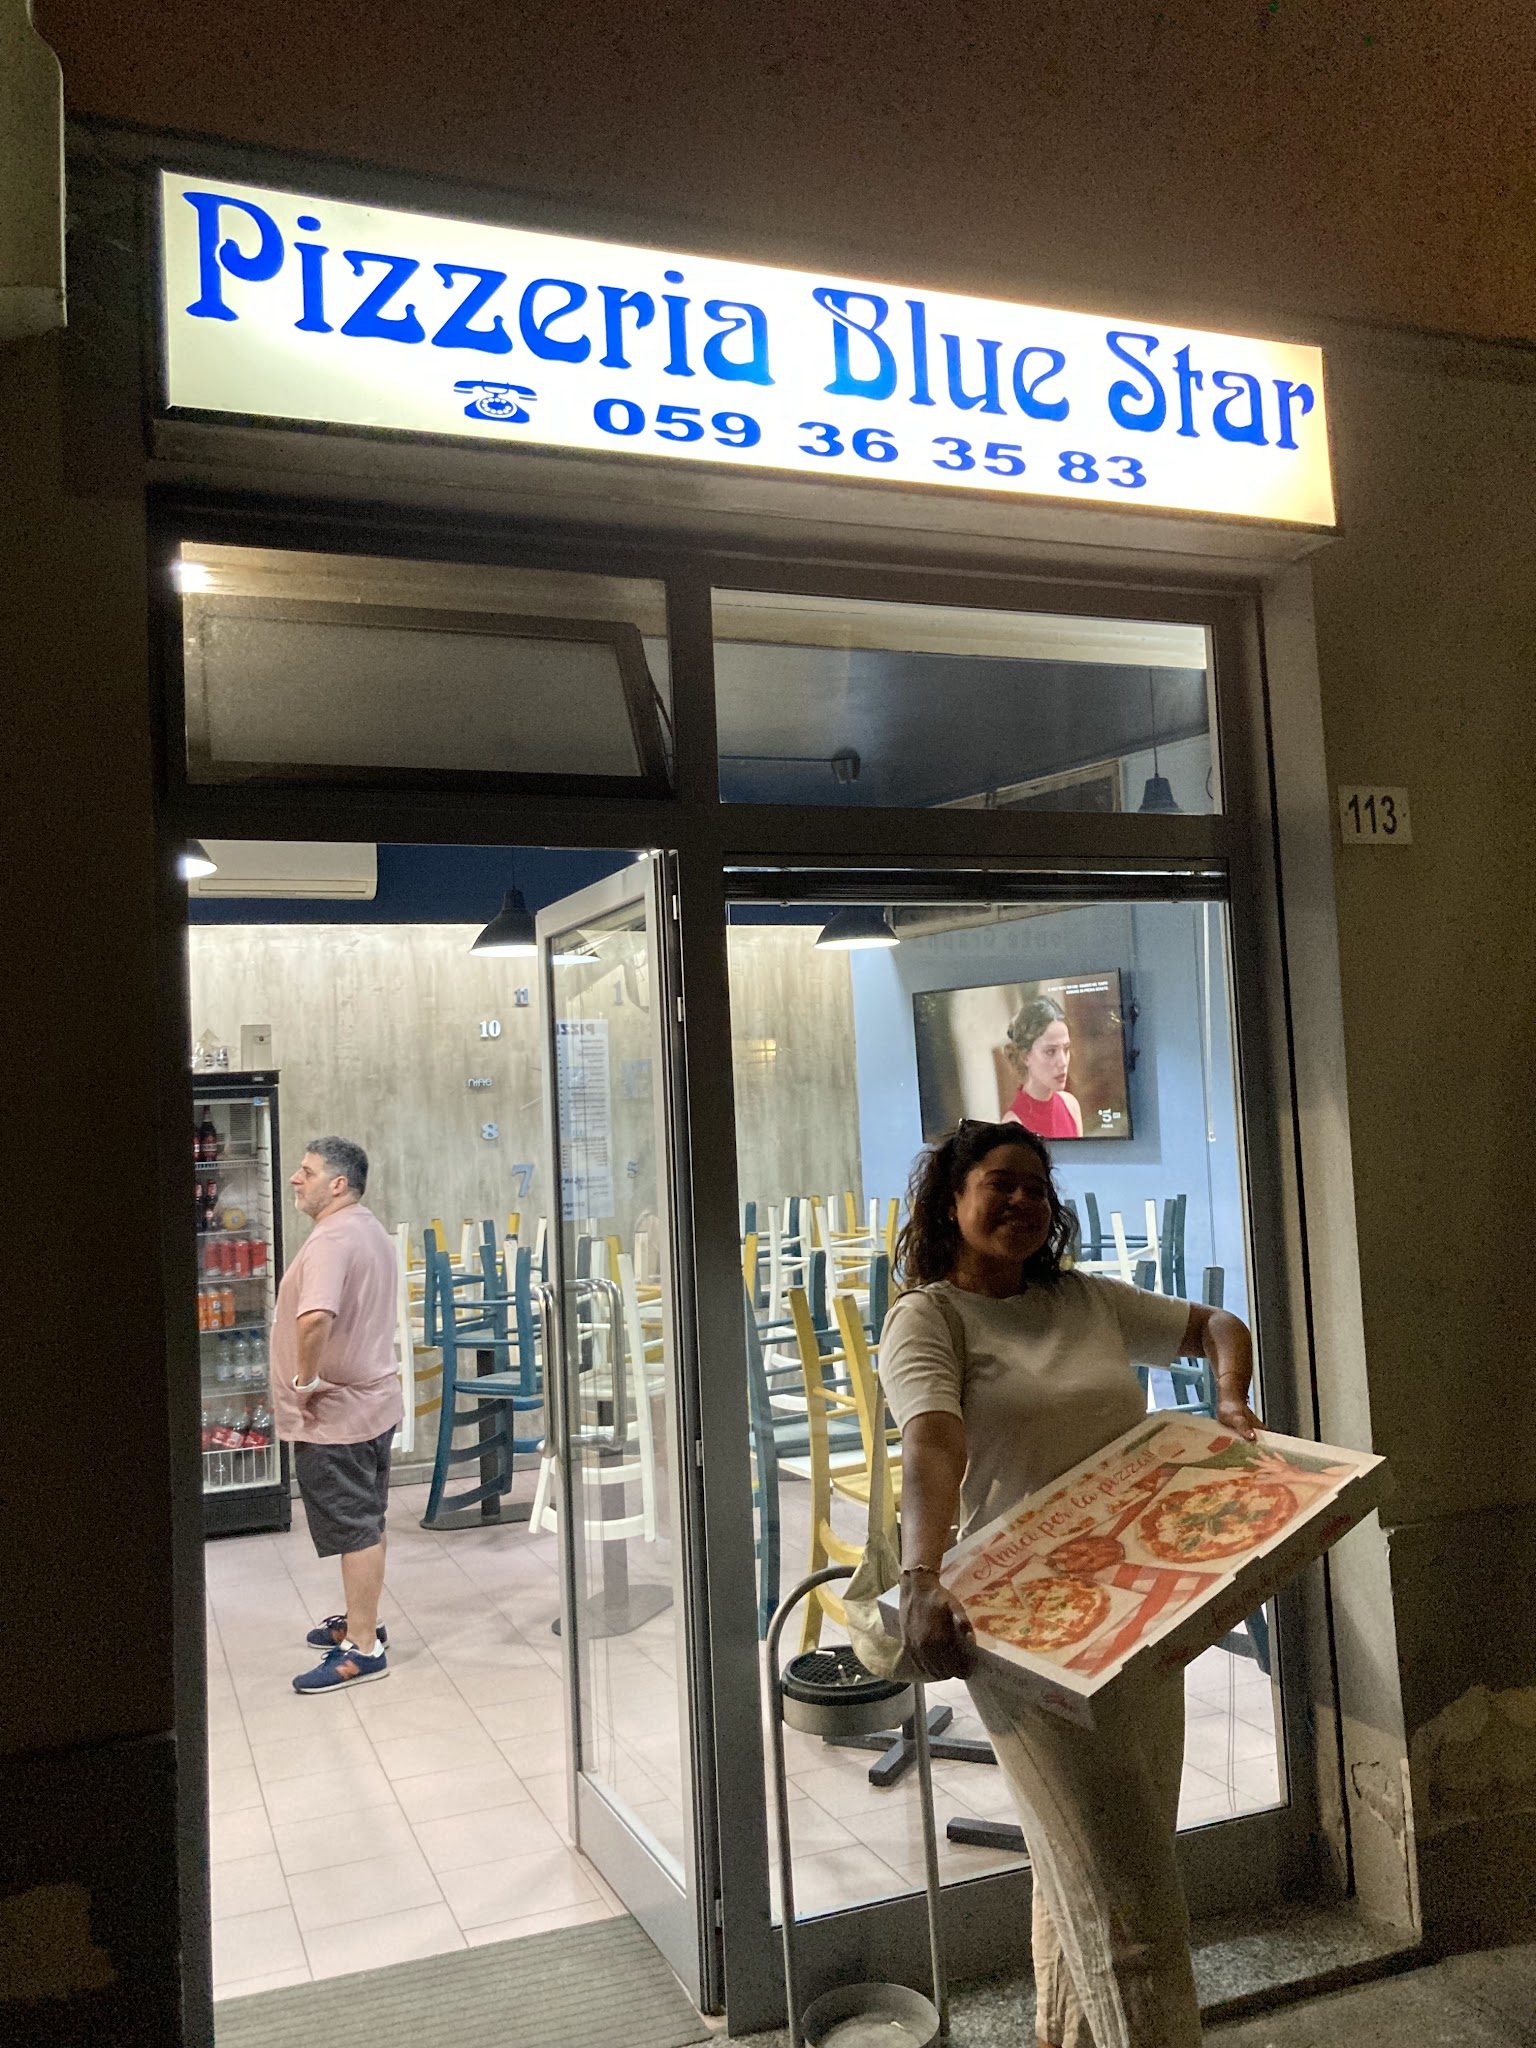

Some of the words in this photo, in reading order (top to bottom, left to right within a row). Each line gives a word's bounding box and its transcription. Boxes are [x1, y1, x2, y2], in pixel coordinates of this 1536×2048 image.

[182, 191, 775, 387] Pizzeria
[811, 286, 1071, 423] Blue
[1105, 330, 1316, 452] Star
[592, 397, 762, 449] 059
[799, 421, 899, 464] 36
[933, 436, 1026, 477] 35
[1057, 450, 1147, 489] 83
[1348, 794, 1398, 834] 113
[479, 1019, 502, 1038] 10
[482, 1122, 500, 1140] 8
[511, 1163, 535, 1198] 7
[1070, 1493, 1098, 1509] la
